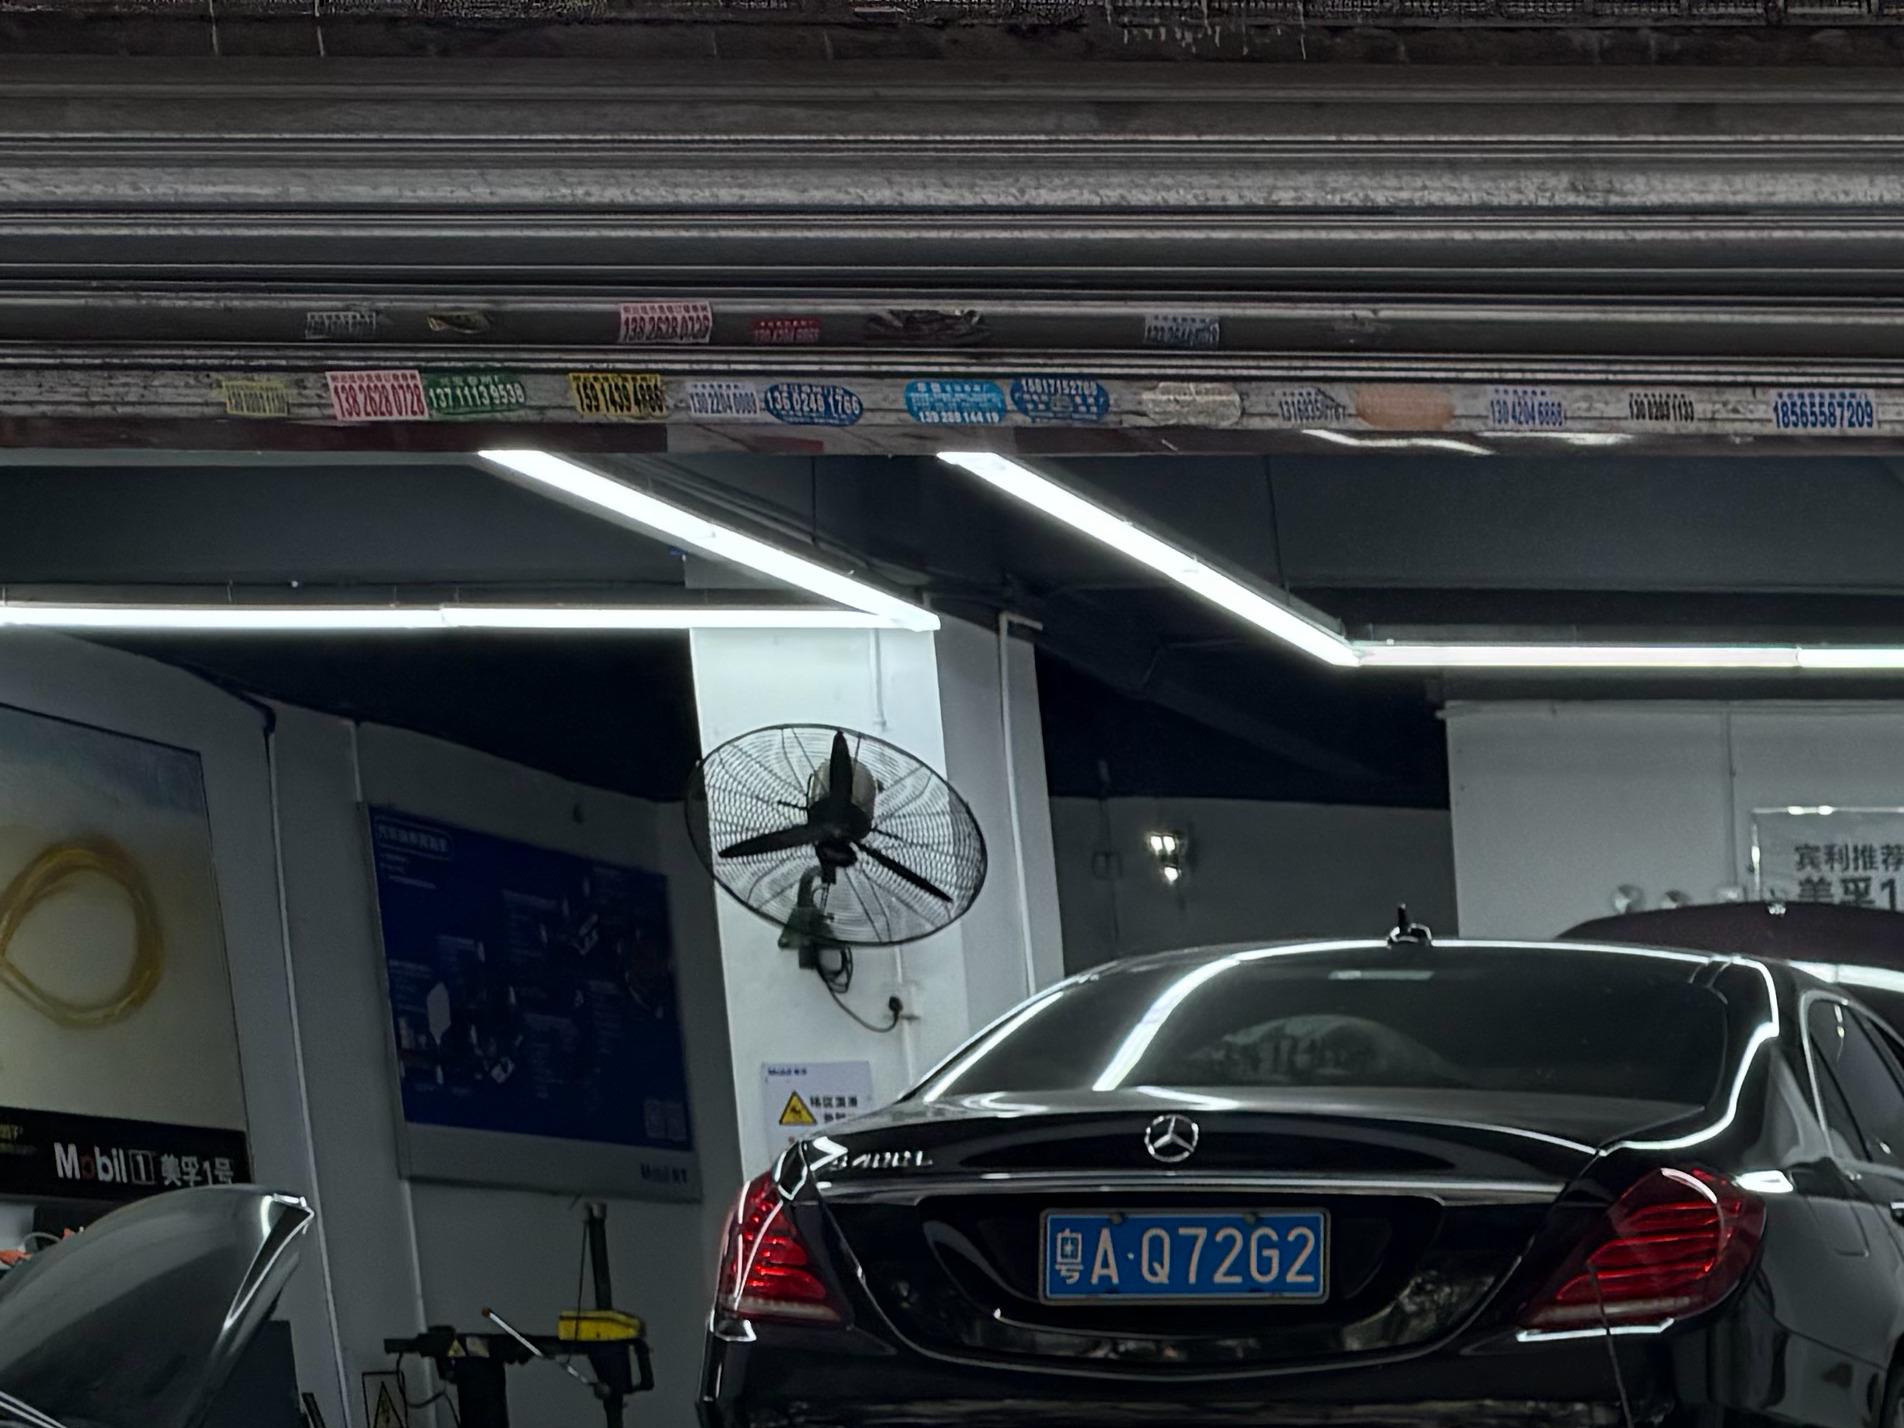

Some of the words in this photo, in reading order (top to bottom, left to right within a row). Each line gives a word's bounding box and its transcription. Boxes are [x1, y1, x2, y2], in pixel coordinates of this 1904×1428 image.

[333, 384, 361, 417] 138
[358, 383, 393, 417] 2628
[390, 383, 426, 416] 0728
[428, 387, 452, 409] 137
[1772, 400, 1874, 429] 18565587209
[54, 1142, 128, 1184] Mobil
[160, 1153, 235, 1187] 美孚1号
